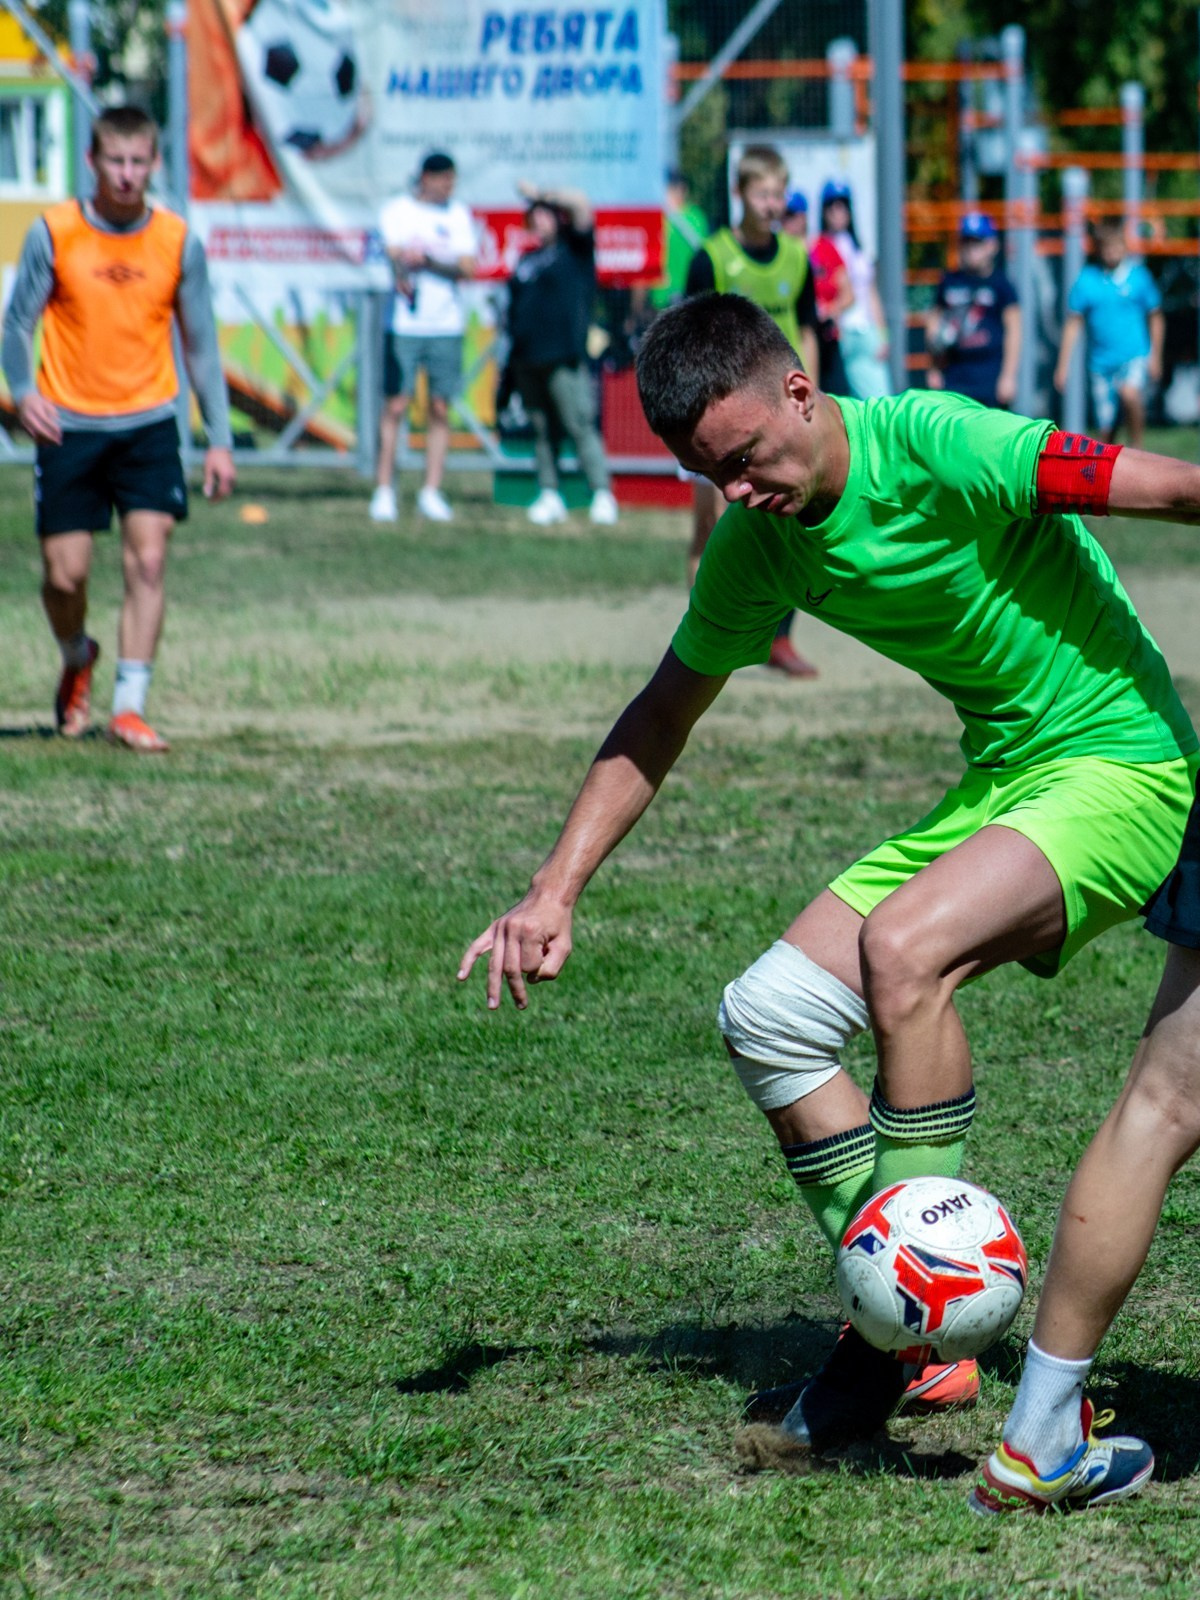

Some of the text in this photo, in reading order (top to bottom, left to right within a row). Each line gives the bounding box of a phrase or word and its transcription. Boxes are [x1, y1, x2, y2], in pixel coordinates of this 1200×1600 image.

[481, 11, 639, 53] РЕБЯТА
[387, 64, 643, 100] НАШЕГО ДВОРА
[922, 1193, 973, 1225] JAKO
